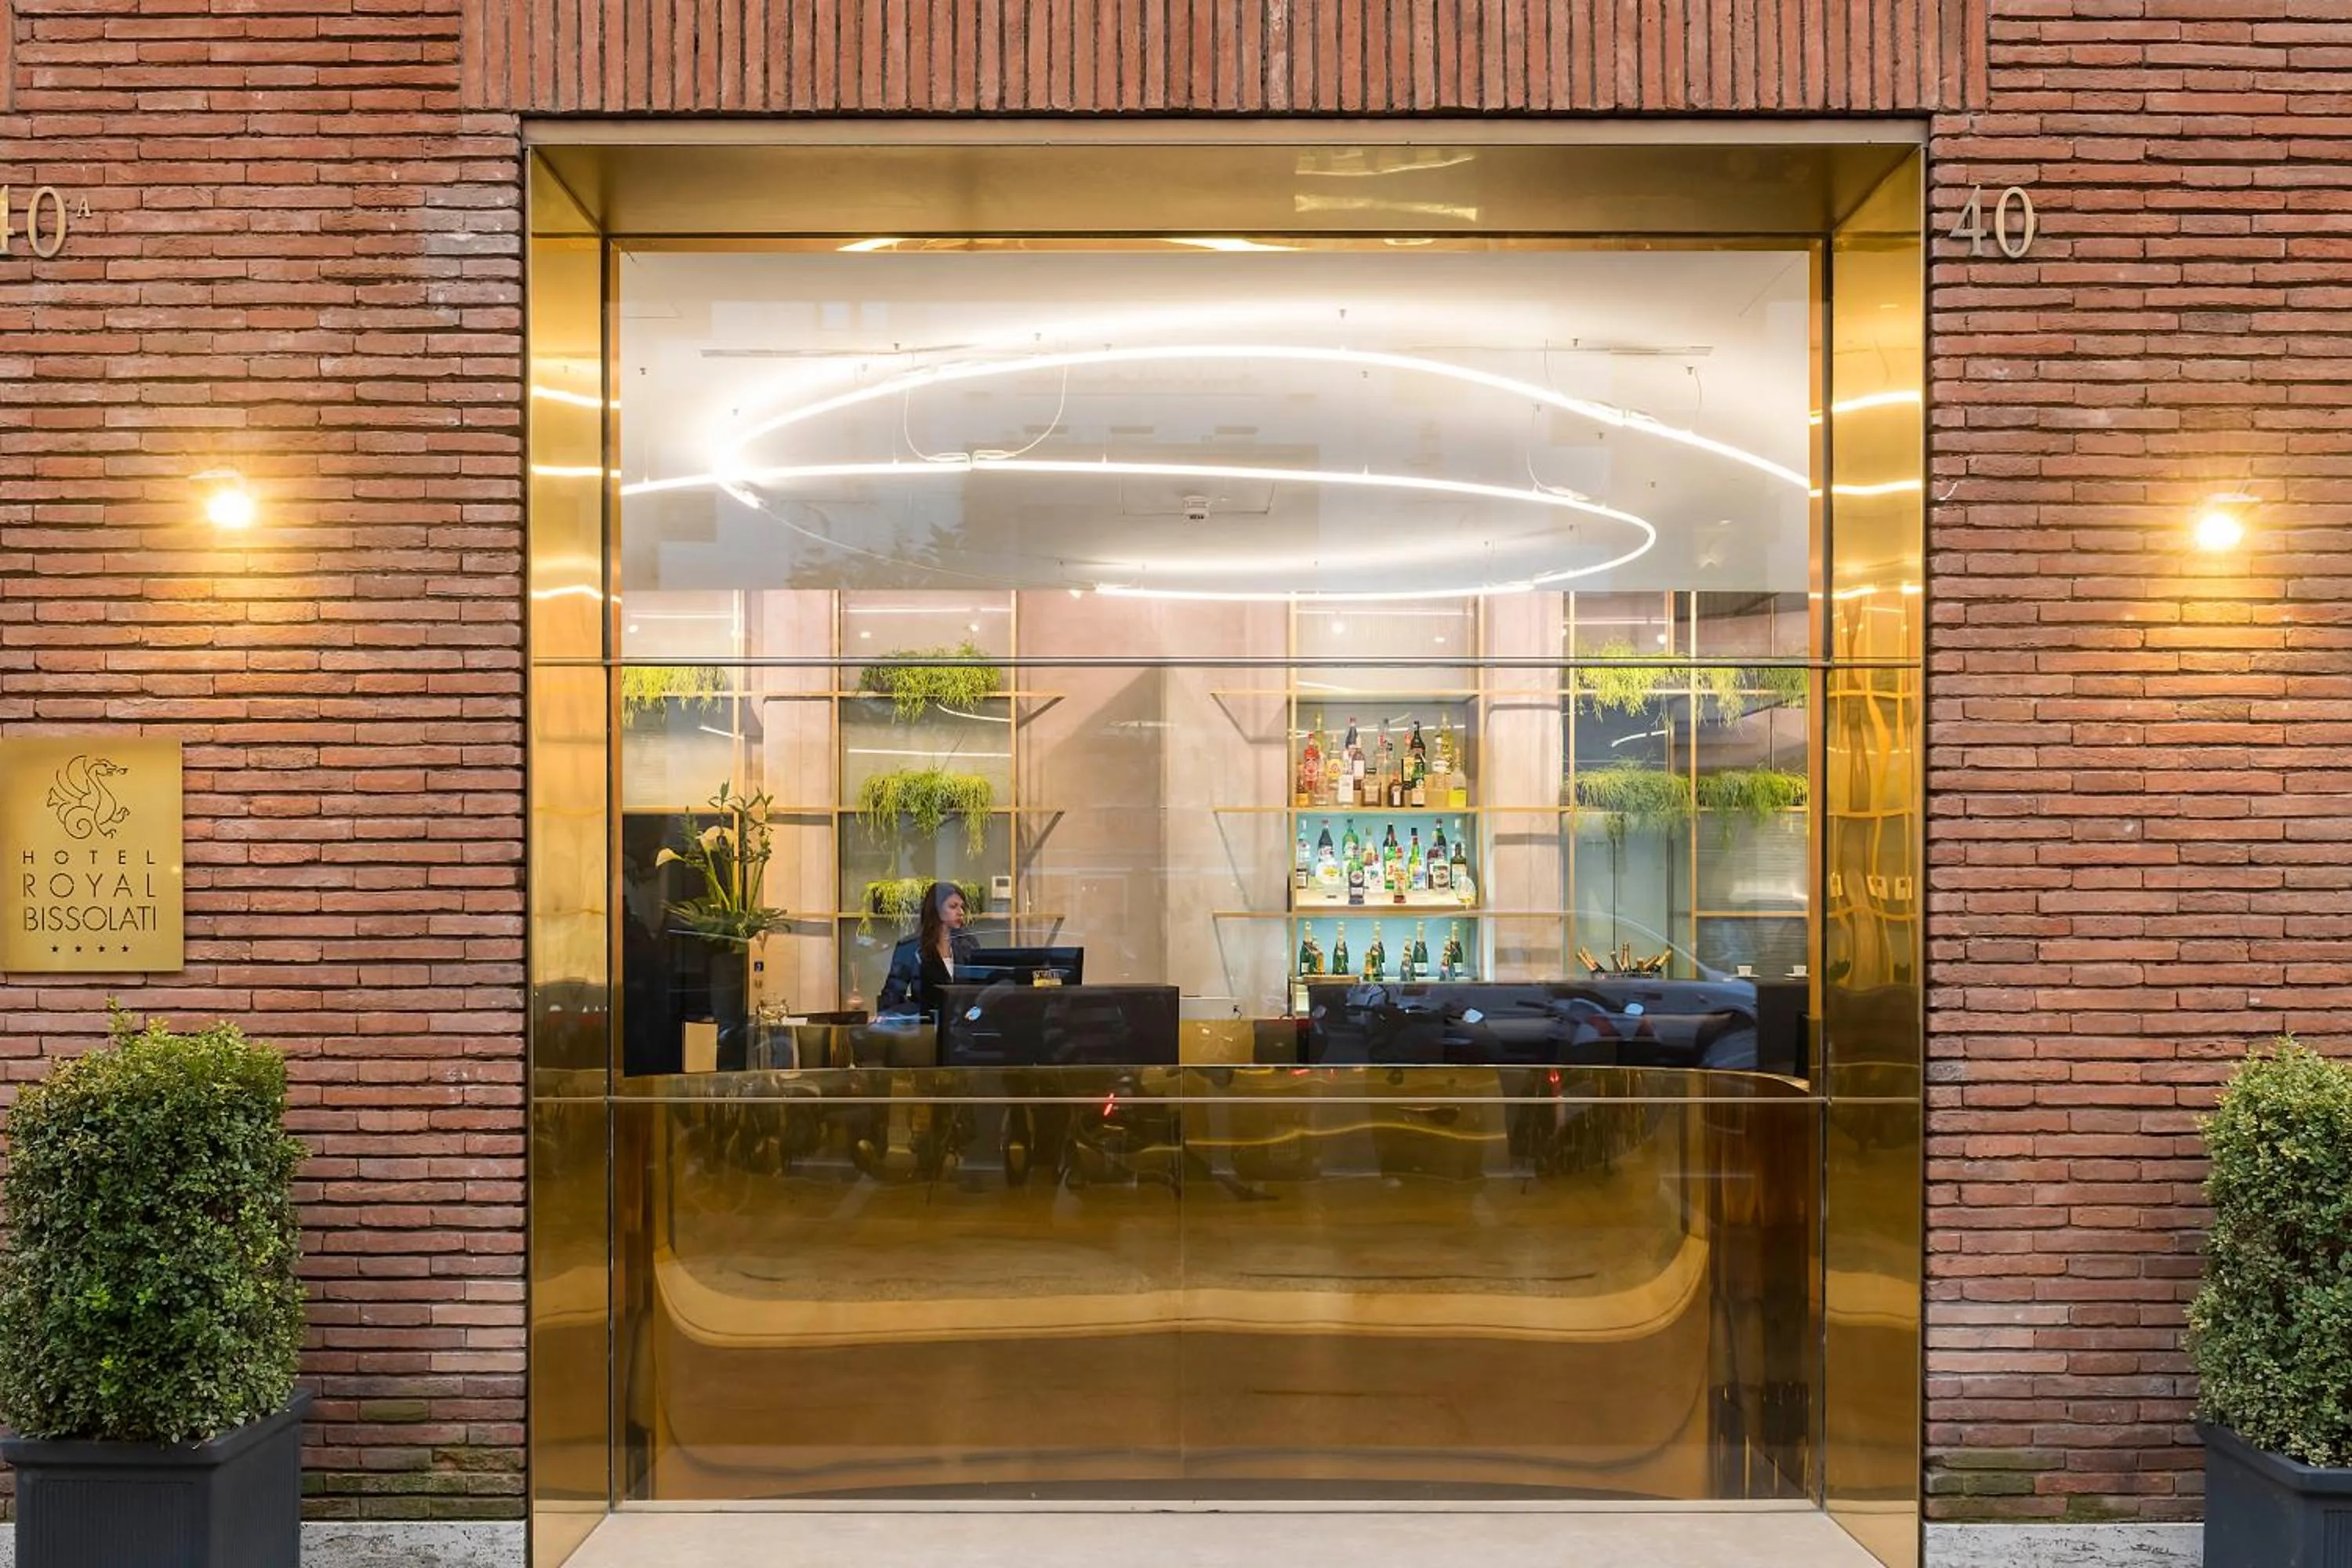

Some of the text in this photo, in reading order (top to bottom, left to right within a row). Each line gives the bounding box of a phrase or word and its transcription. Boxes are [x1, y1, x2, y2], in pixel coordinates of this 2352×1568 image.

[1949, 184, 2034, 259] 40
[23, 850, 155, 865] HOTEL
[23, 873, 156, 898] ROYAL
[24, 906, 156, 931] BISSOLATI
